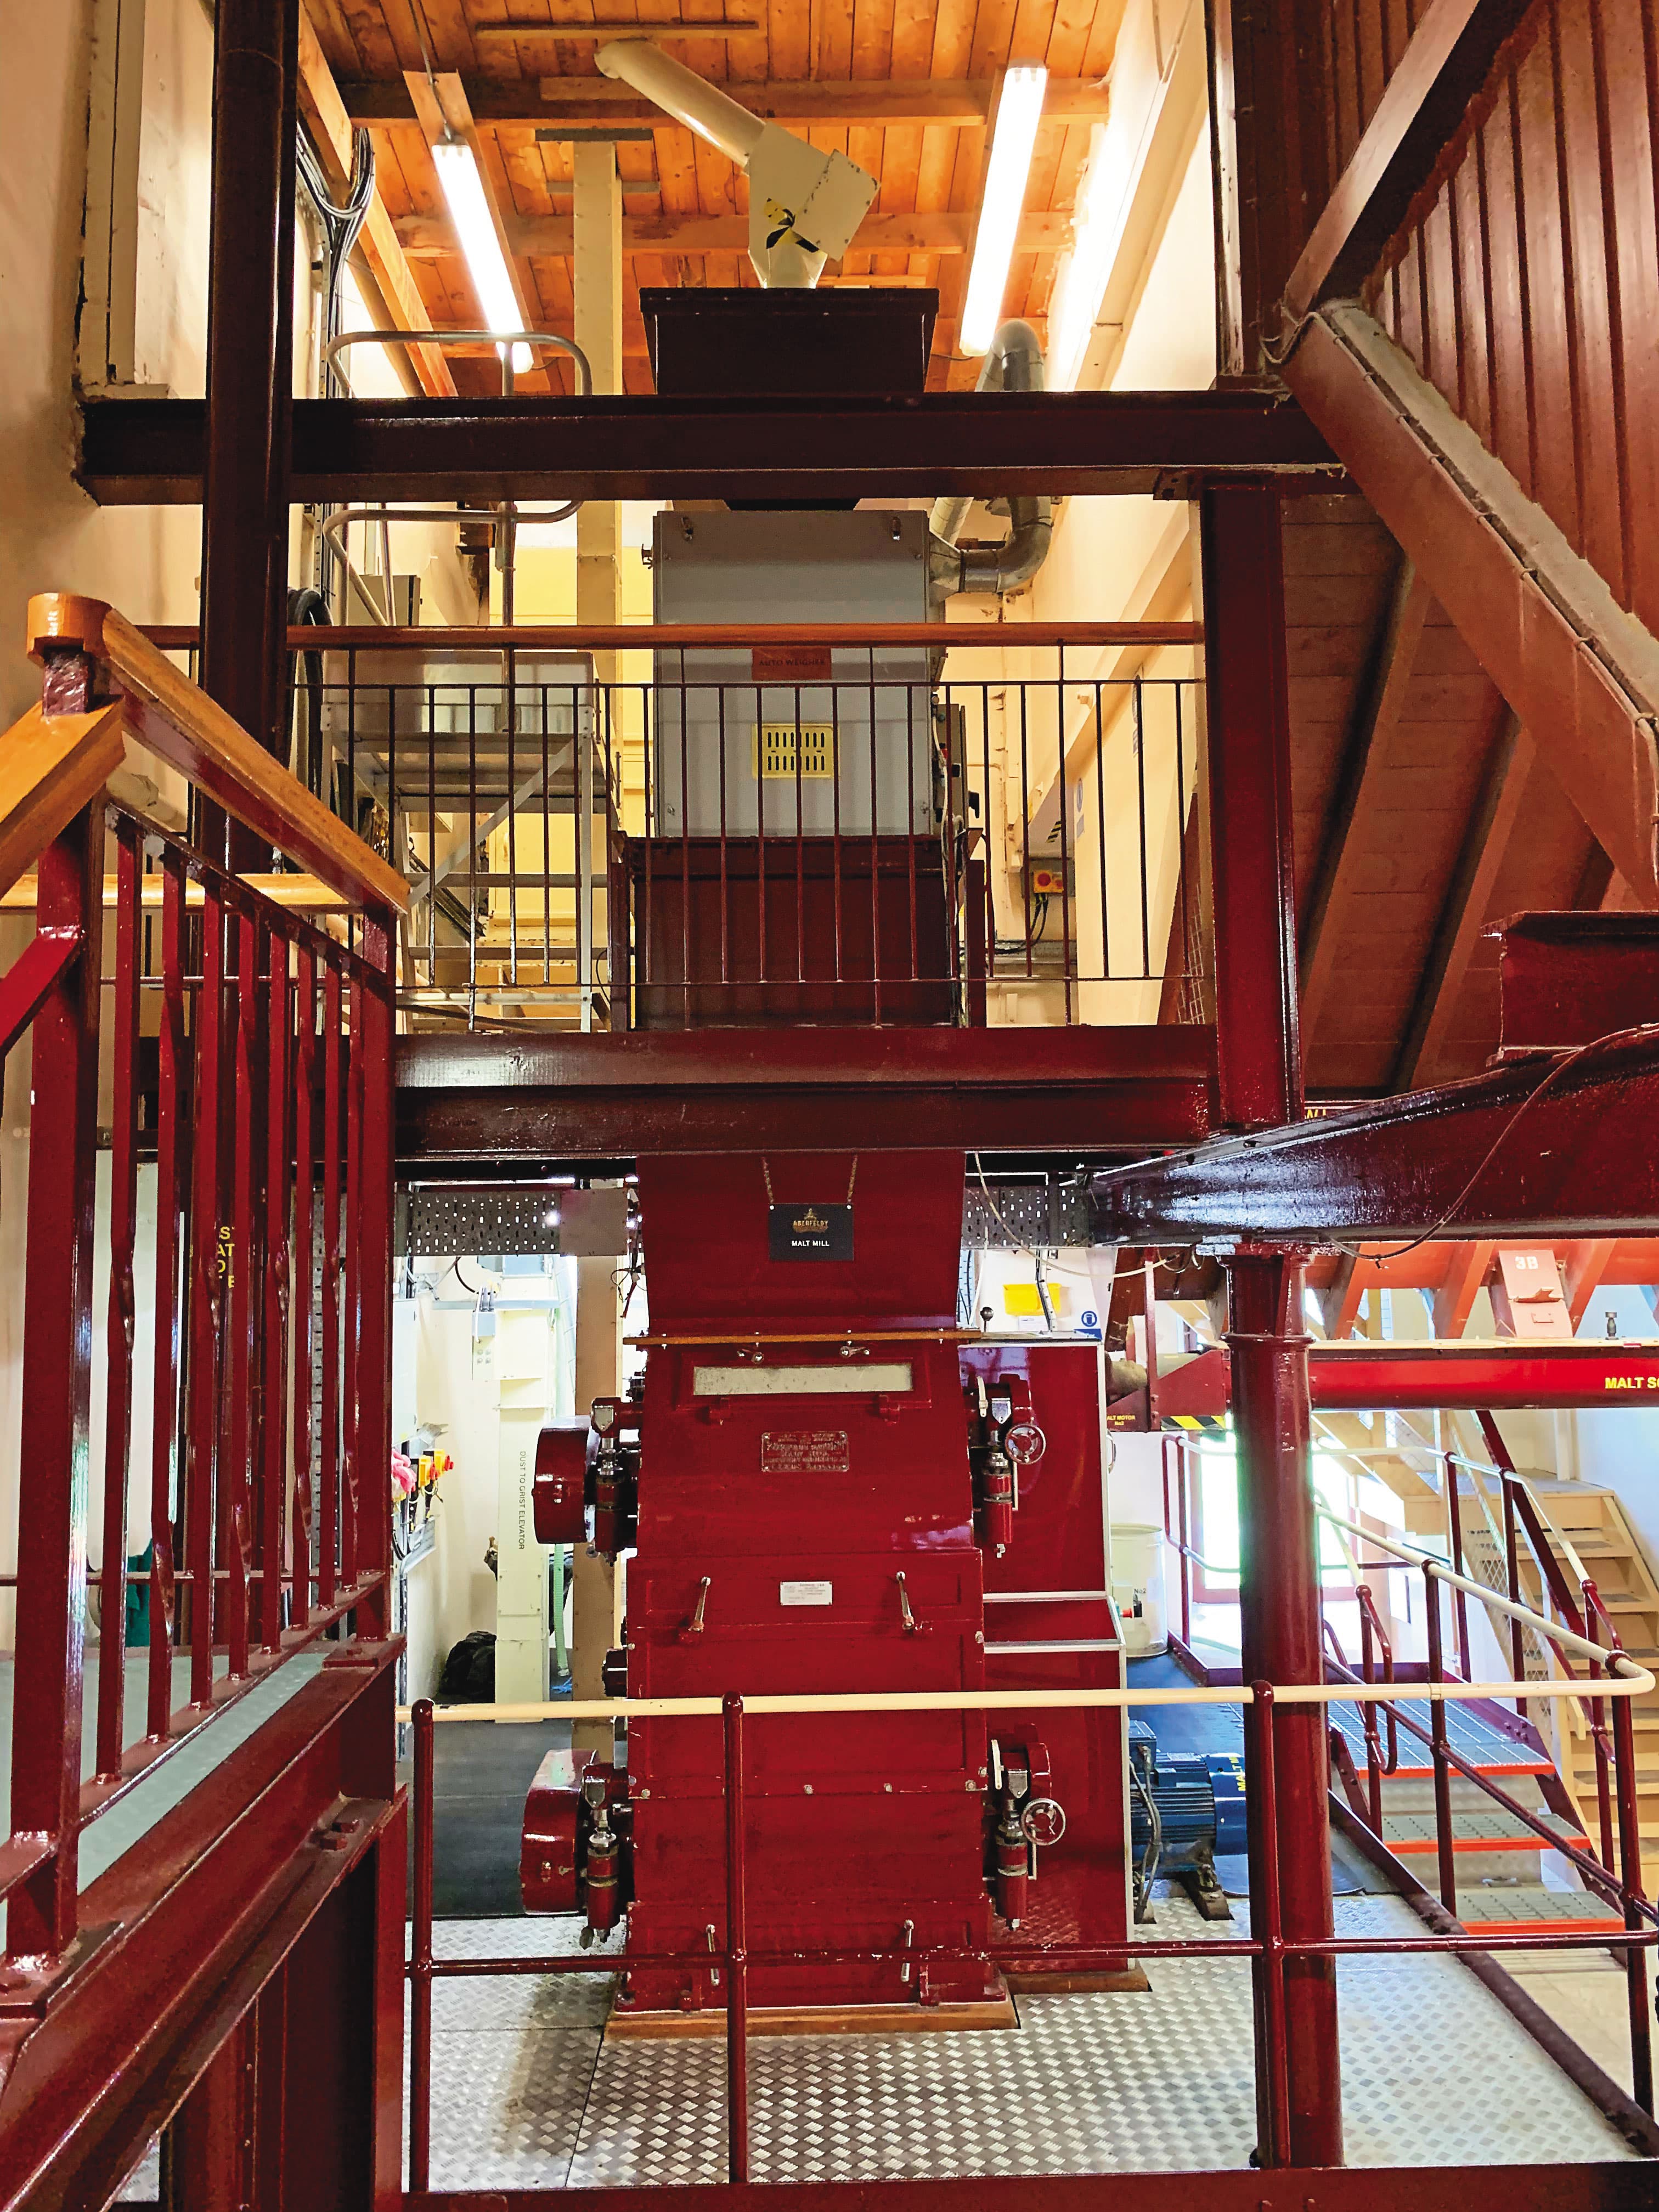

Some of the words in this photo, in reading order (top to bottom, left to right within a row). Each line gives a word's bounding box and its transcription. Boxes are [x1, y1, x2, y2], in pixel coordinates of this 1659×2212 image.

[1515, 1256, 1539, 1269] 3B
[1605, 1377, 1645, 1389] MALT
[519, 1474, 526, 1483] TO
